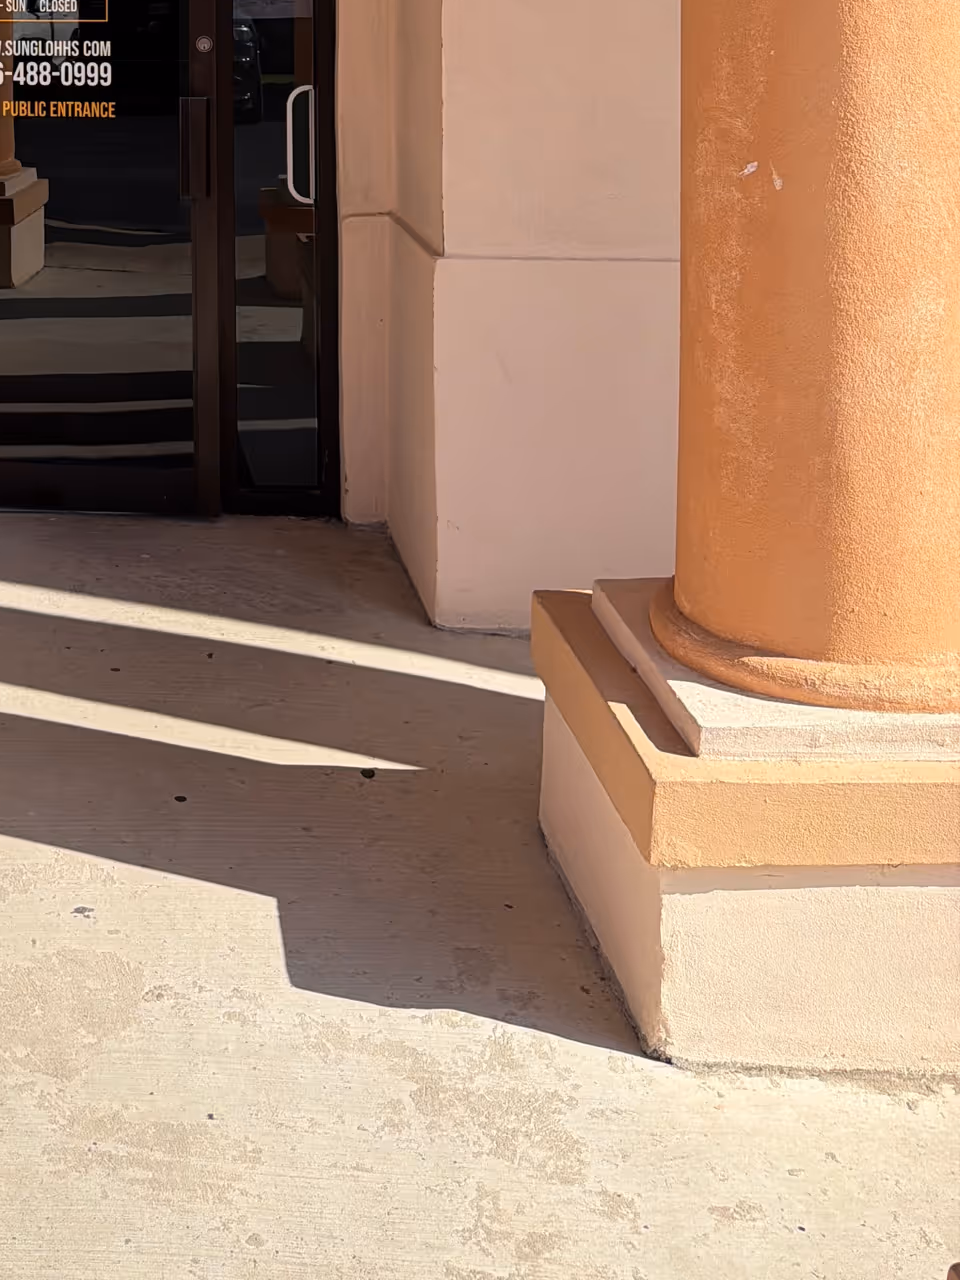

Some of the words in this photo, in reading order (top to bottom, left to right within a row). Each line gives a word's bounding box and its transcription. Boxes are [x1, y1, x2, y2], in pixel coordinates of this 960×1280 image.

[6, 0, 26, 12] SUN
[39, 0, 77, 12] CLOSED
[2, 101, 47, 118] PUBLIC
[50, 101, 116, 118] ENTRANCE
